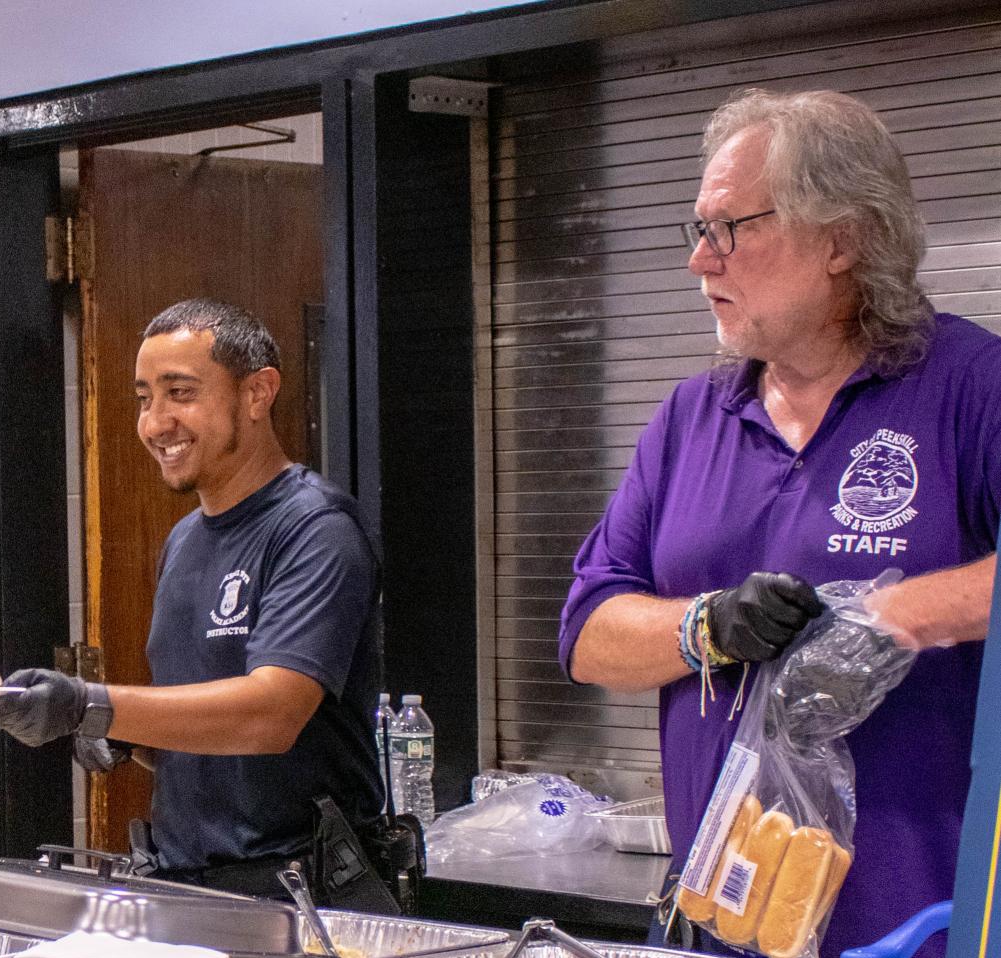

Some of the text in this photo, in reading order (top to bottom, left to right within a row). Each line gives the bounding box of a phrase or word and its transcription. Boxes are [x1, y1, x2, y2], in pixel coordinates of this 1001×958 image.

[850, 440, 869, 458] CITY
[876, 428, 919, 454] PEEKSKILL
[829, 503, 919, 533] PARKS & RECREATION
[827, 534, 908, 556] STAFF
